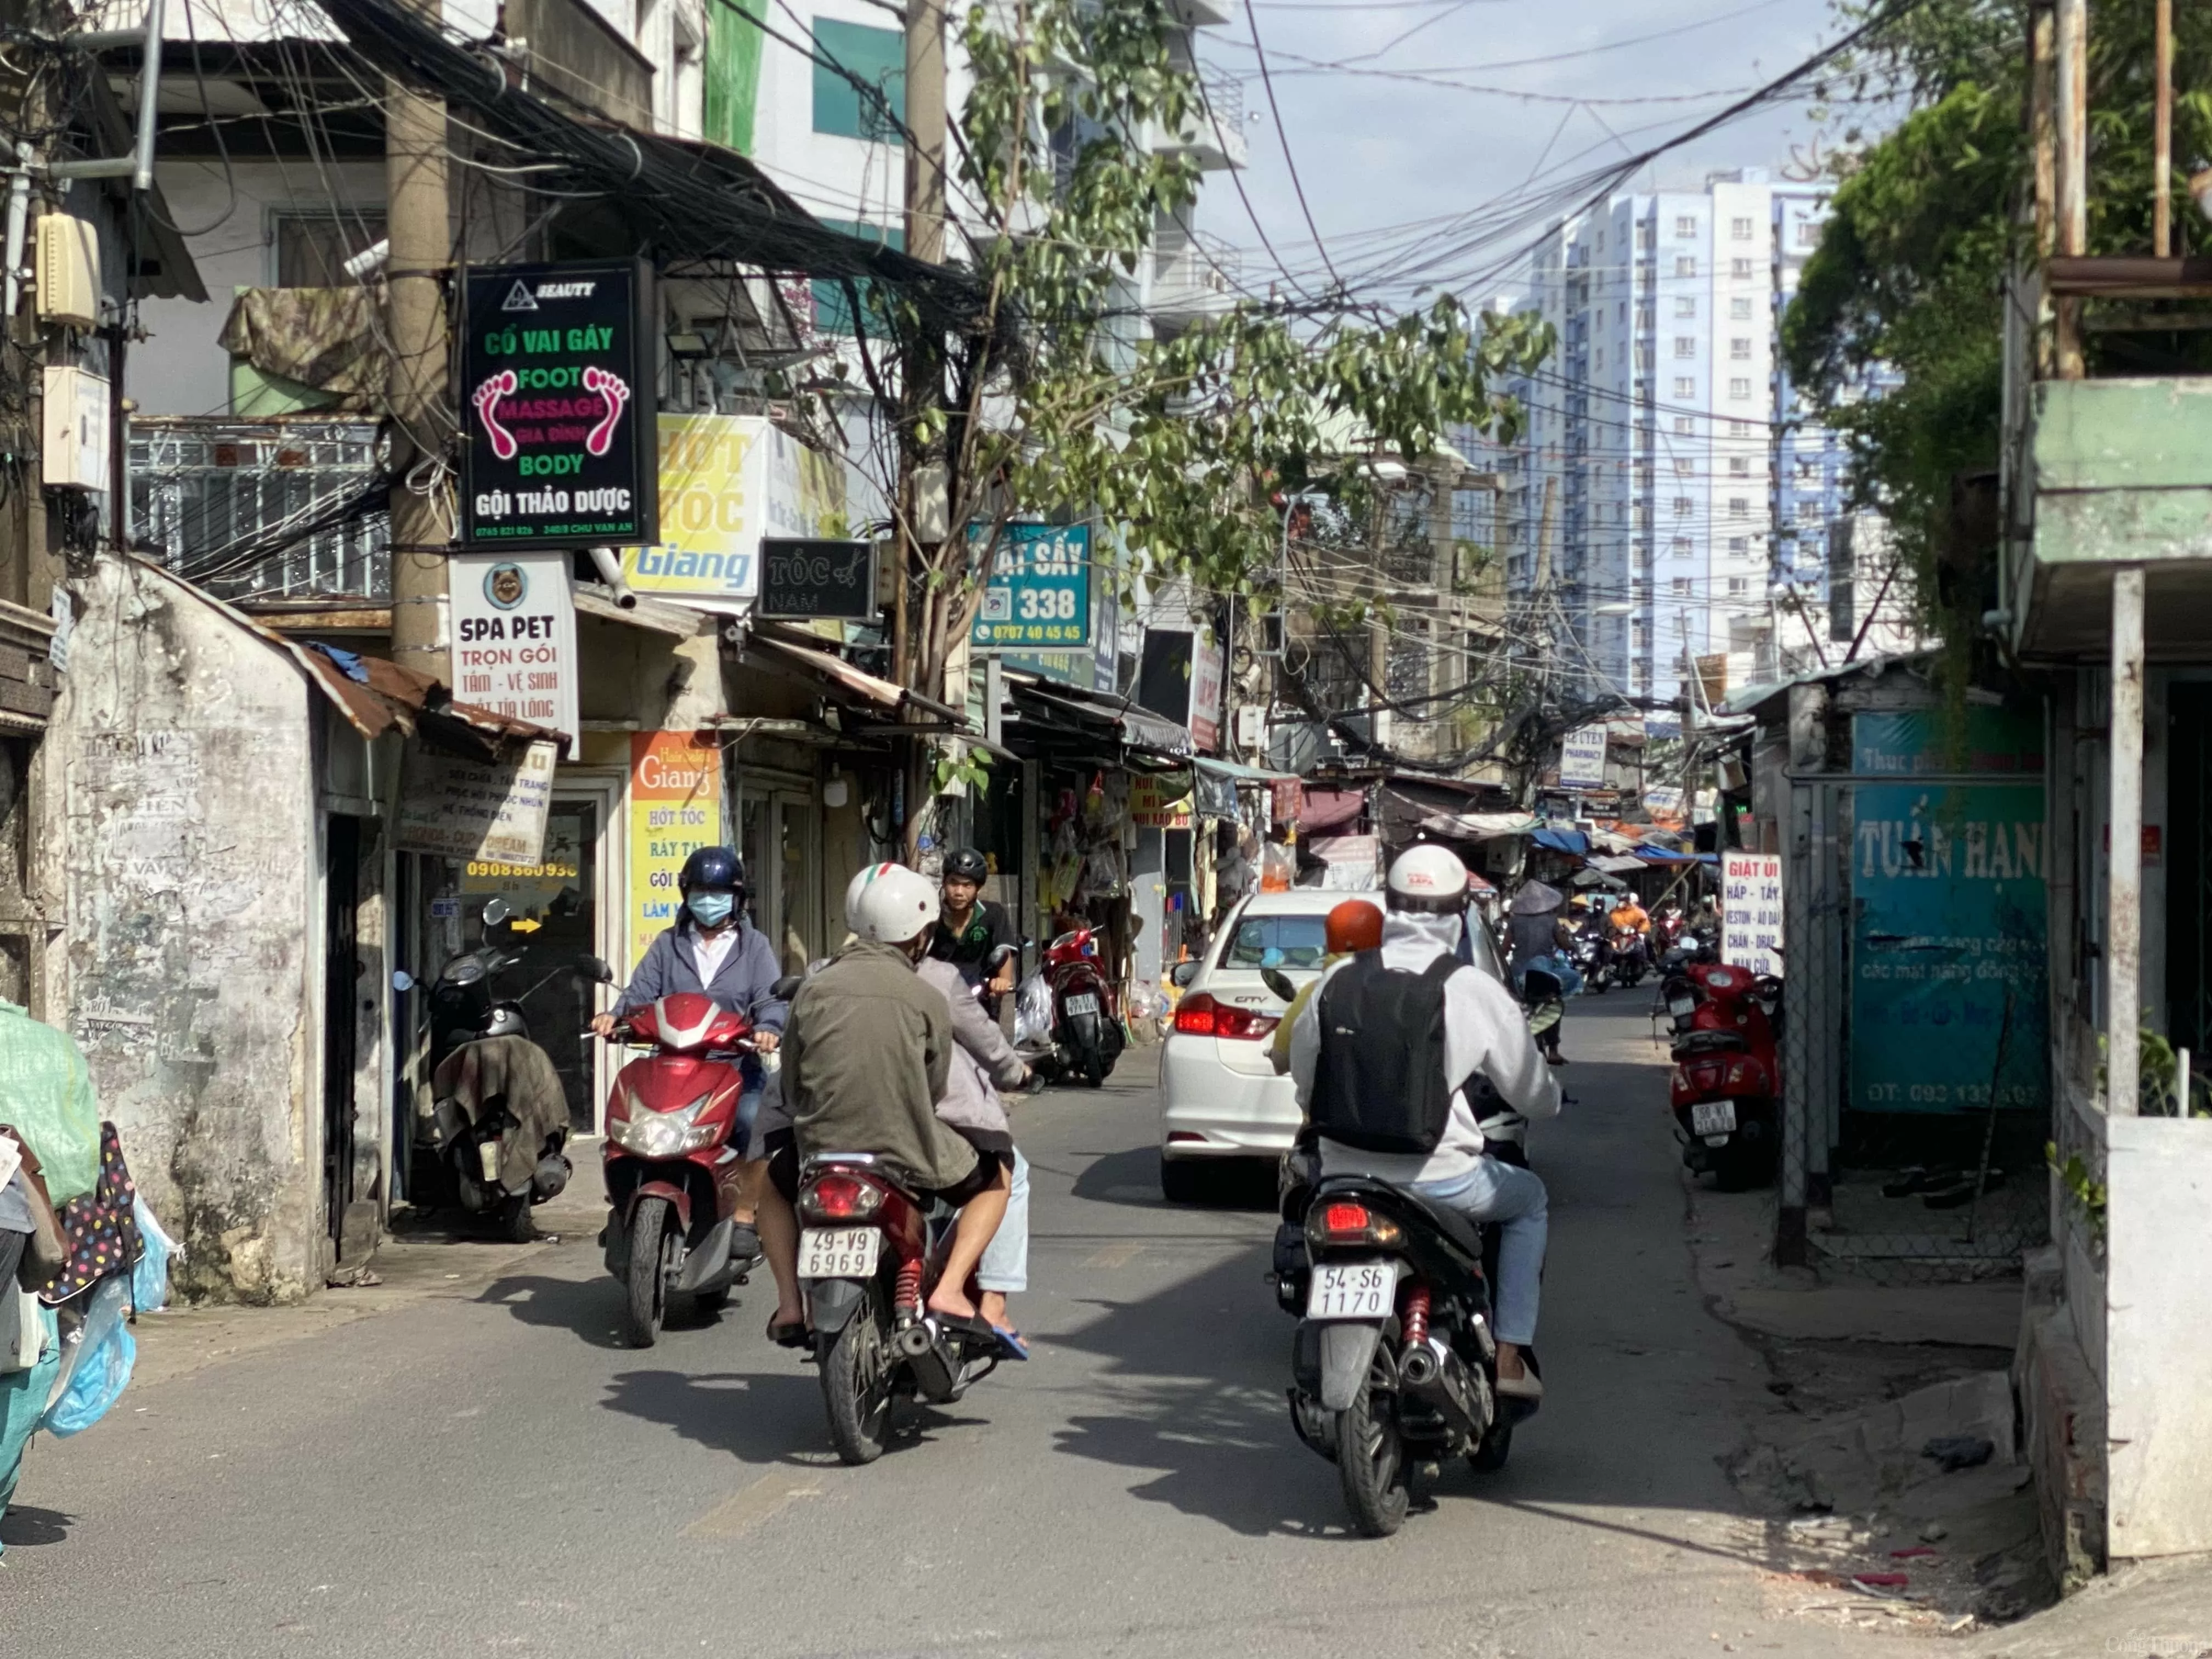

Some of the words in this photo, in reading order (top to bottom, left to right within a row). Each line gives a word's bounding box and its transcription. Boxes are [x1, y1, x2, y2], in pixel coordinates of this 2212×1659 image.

[536, 282, 596, 299] BEAUTY
[522, 330, 560, 353] VAI
[518, 367, 581, 388] FOOT
[499, 397, 603, 420] MASSAGE
[520, 454, 584, 476] BODY
[476, 489, 511, 520] GỘI
[516, 485, 568, 514] THẢO
[575, 487, 630, 516] DƯỢC
[1034, 532, 1083, 575] SẤY
[636, 544, 750, 588] Giang
[1020, 588, 1075, 619] 338
[460, 617, 505, 642] SPA
[512, 615, 554, 640] PET
[1027, 626, 1042, 640] 40
[1046, 626, 1062, 639] 45
[1064, 626, 1080, 639] 45
[461, 650, 512, 670] TRỌN
[519, 642, 556, 664] GÓI
[528, 672, 557, 690] SINH
[520, 778, 549, 791] TRANG
[640, 755, 710, 796] Giang
[650, 838, 678, 856] RÁY
[1857, 794, 1953, 879] TUẤN
[650, 868, 673, 891] GỘI
[1729, 859, 1760, 881] GIẶT
[643, 899, 669, 918] LÀM
[1756, 934, 1776, 949] DRAP
[813, 1233, 868, 1251] 49-V9
[810, 1254, 865, 1273] 6969
[1325, 1268, 1383, 1290] 54-S6
[1323, 1292, 1380, 1313] 1170
